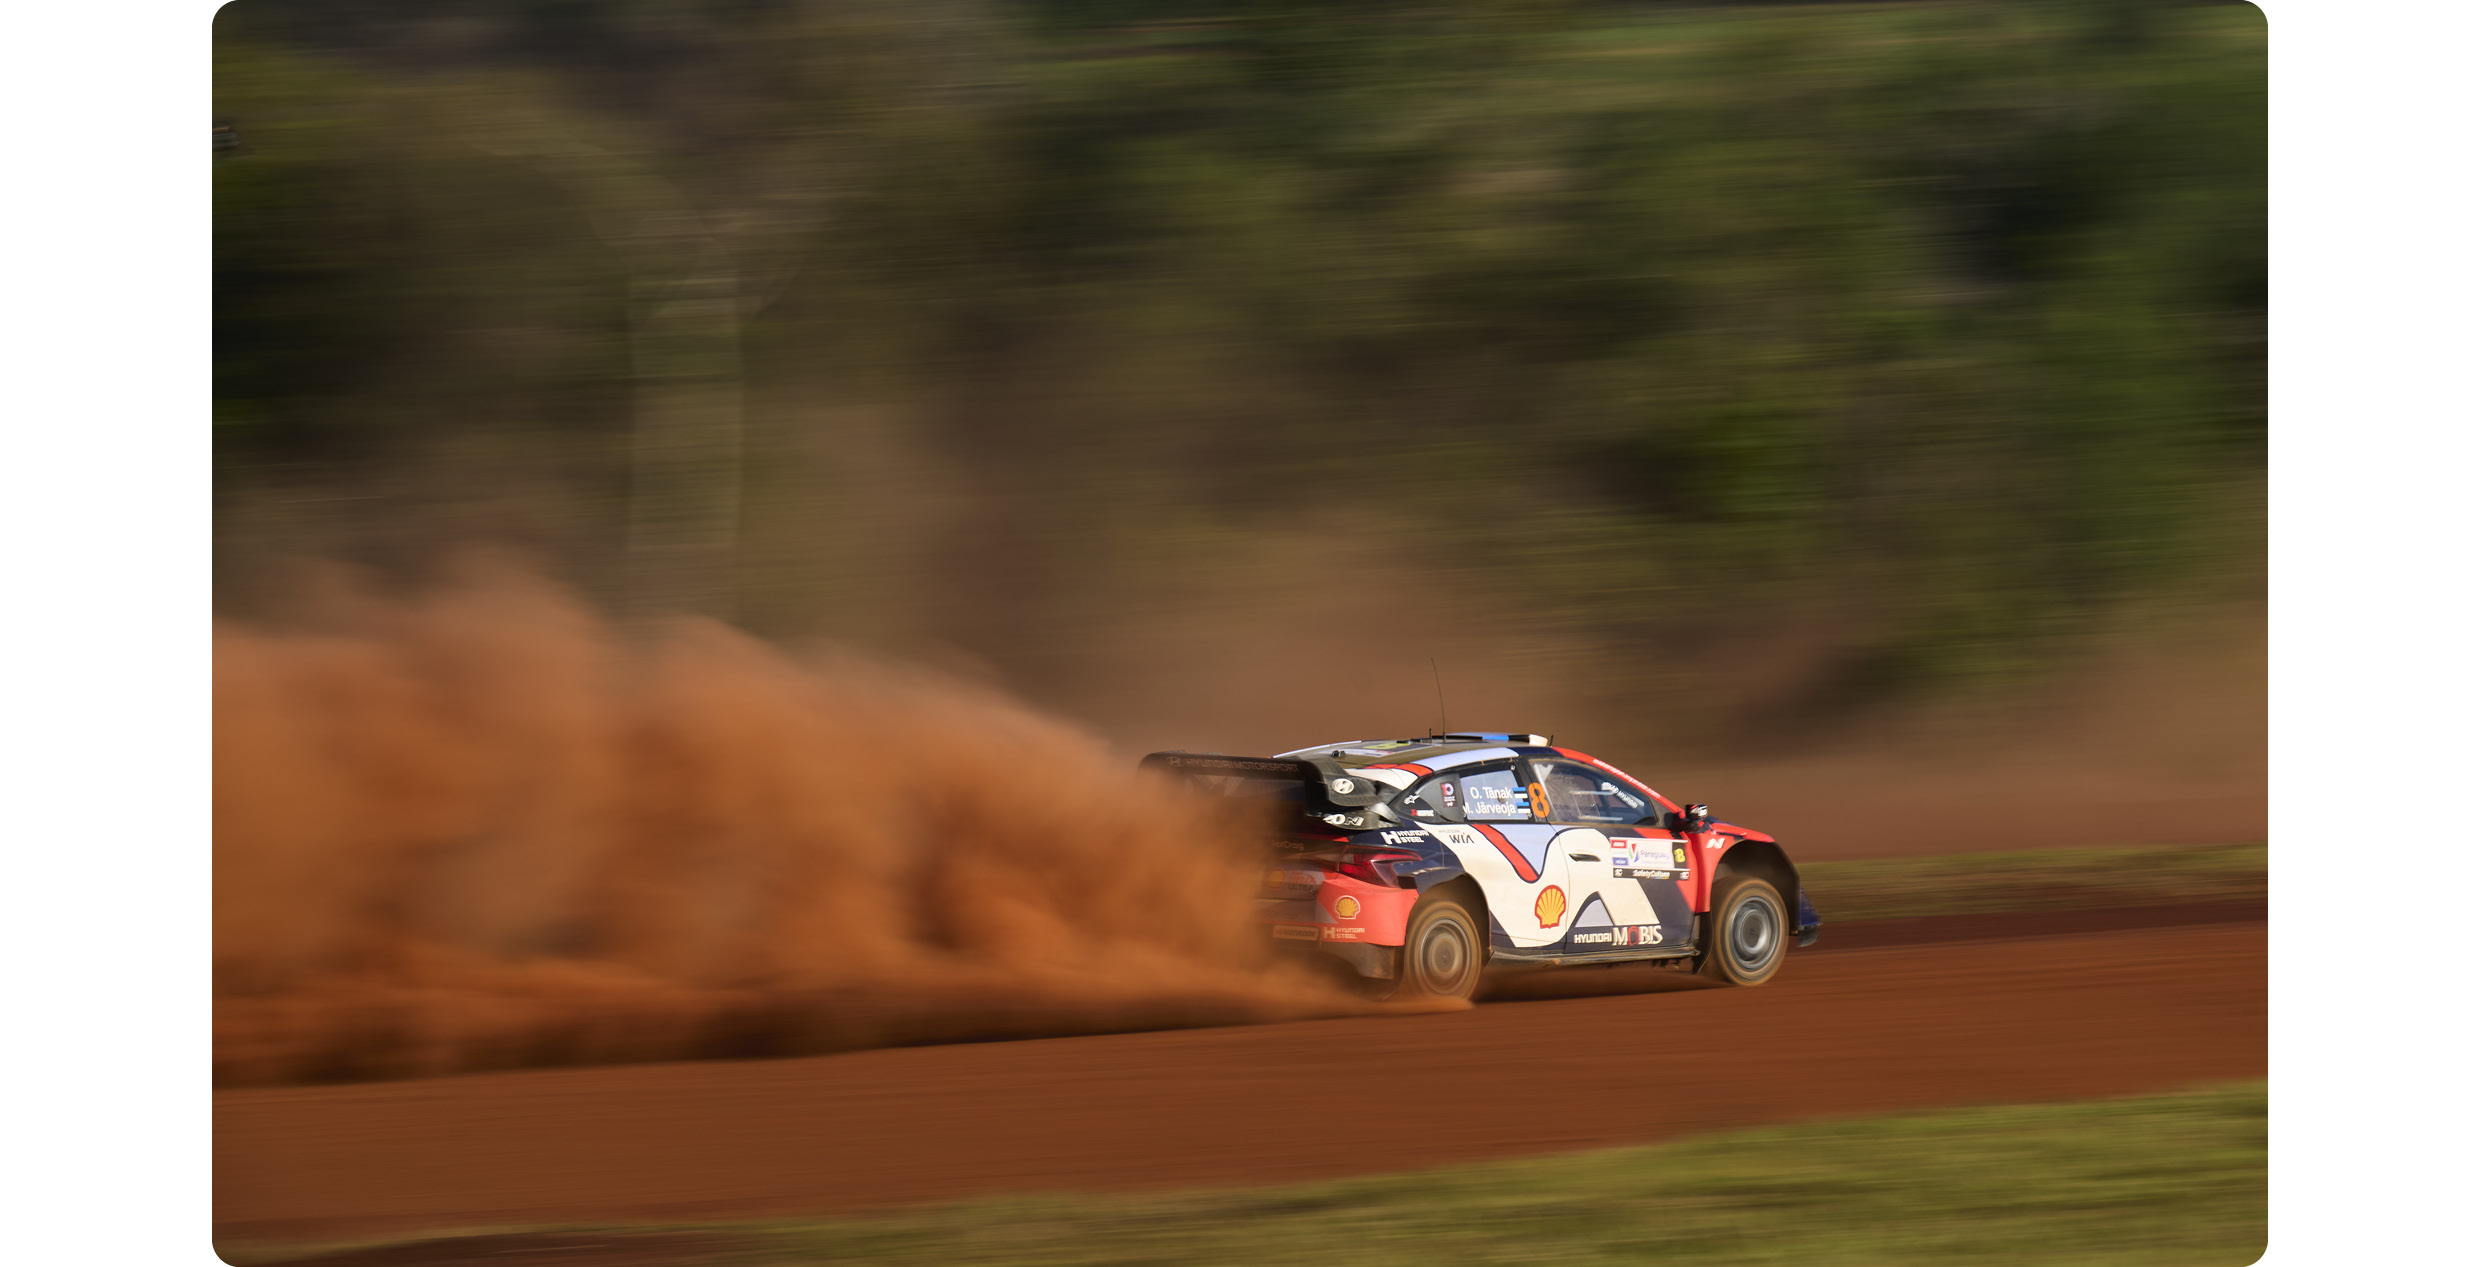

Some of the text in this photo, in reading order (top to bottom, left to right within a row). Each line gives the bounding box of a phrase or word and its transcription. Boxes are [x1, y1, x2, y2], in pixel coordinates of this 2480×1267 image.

[1186, 758, 1300, 773] HYUNDAI MOTORSPORT
[1470, 786, 1482, 799] O.
[1482, 786, 1513, 799] Tänak
[1528, 782, 1550, 819] 8
[1475, 802, 1517, 817] Järveoja
[1399, 836, 1425, 844] STEEL
[1640, 848, 1686, 863] Paraguay 8
[1574, 925, 1664, 946] HYUNDAI MOBIS
